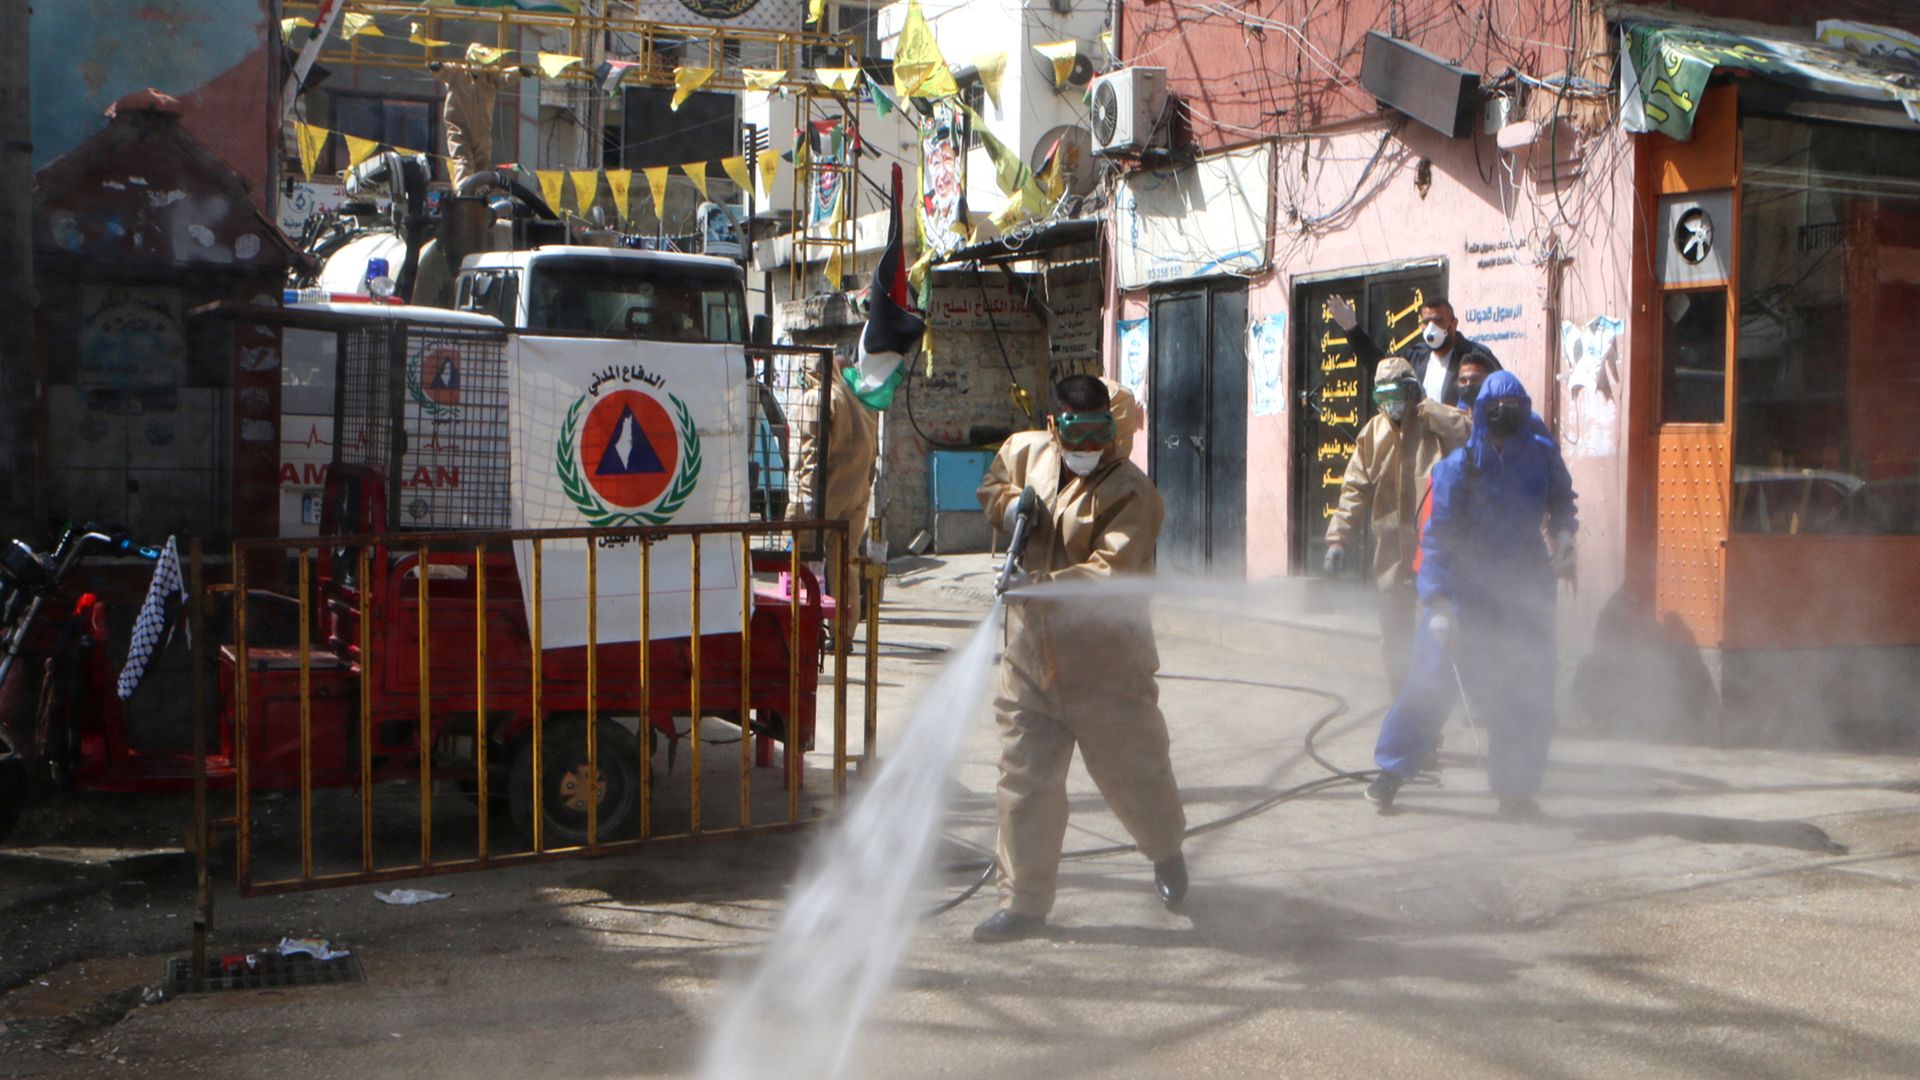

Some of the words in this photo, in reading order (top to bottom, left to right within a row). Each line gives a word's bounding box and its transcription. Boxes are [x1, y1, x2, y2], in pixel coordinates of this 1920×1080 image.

[943, 299, 972, 318] المسلح
[1385, 287, 1424, 329] قهوة
[1493, 304, 1522, 323] الرسول
[588, 364, 620, 398] المدني
[622, 364, 667, 390] الدفاع
[1321, 379, 1358, 403] كابتشينو
[1320, 406, 1359, 427] زهورات
[1317, 437, 1341, 462] طبيعي
